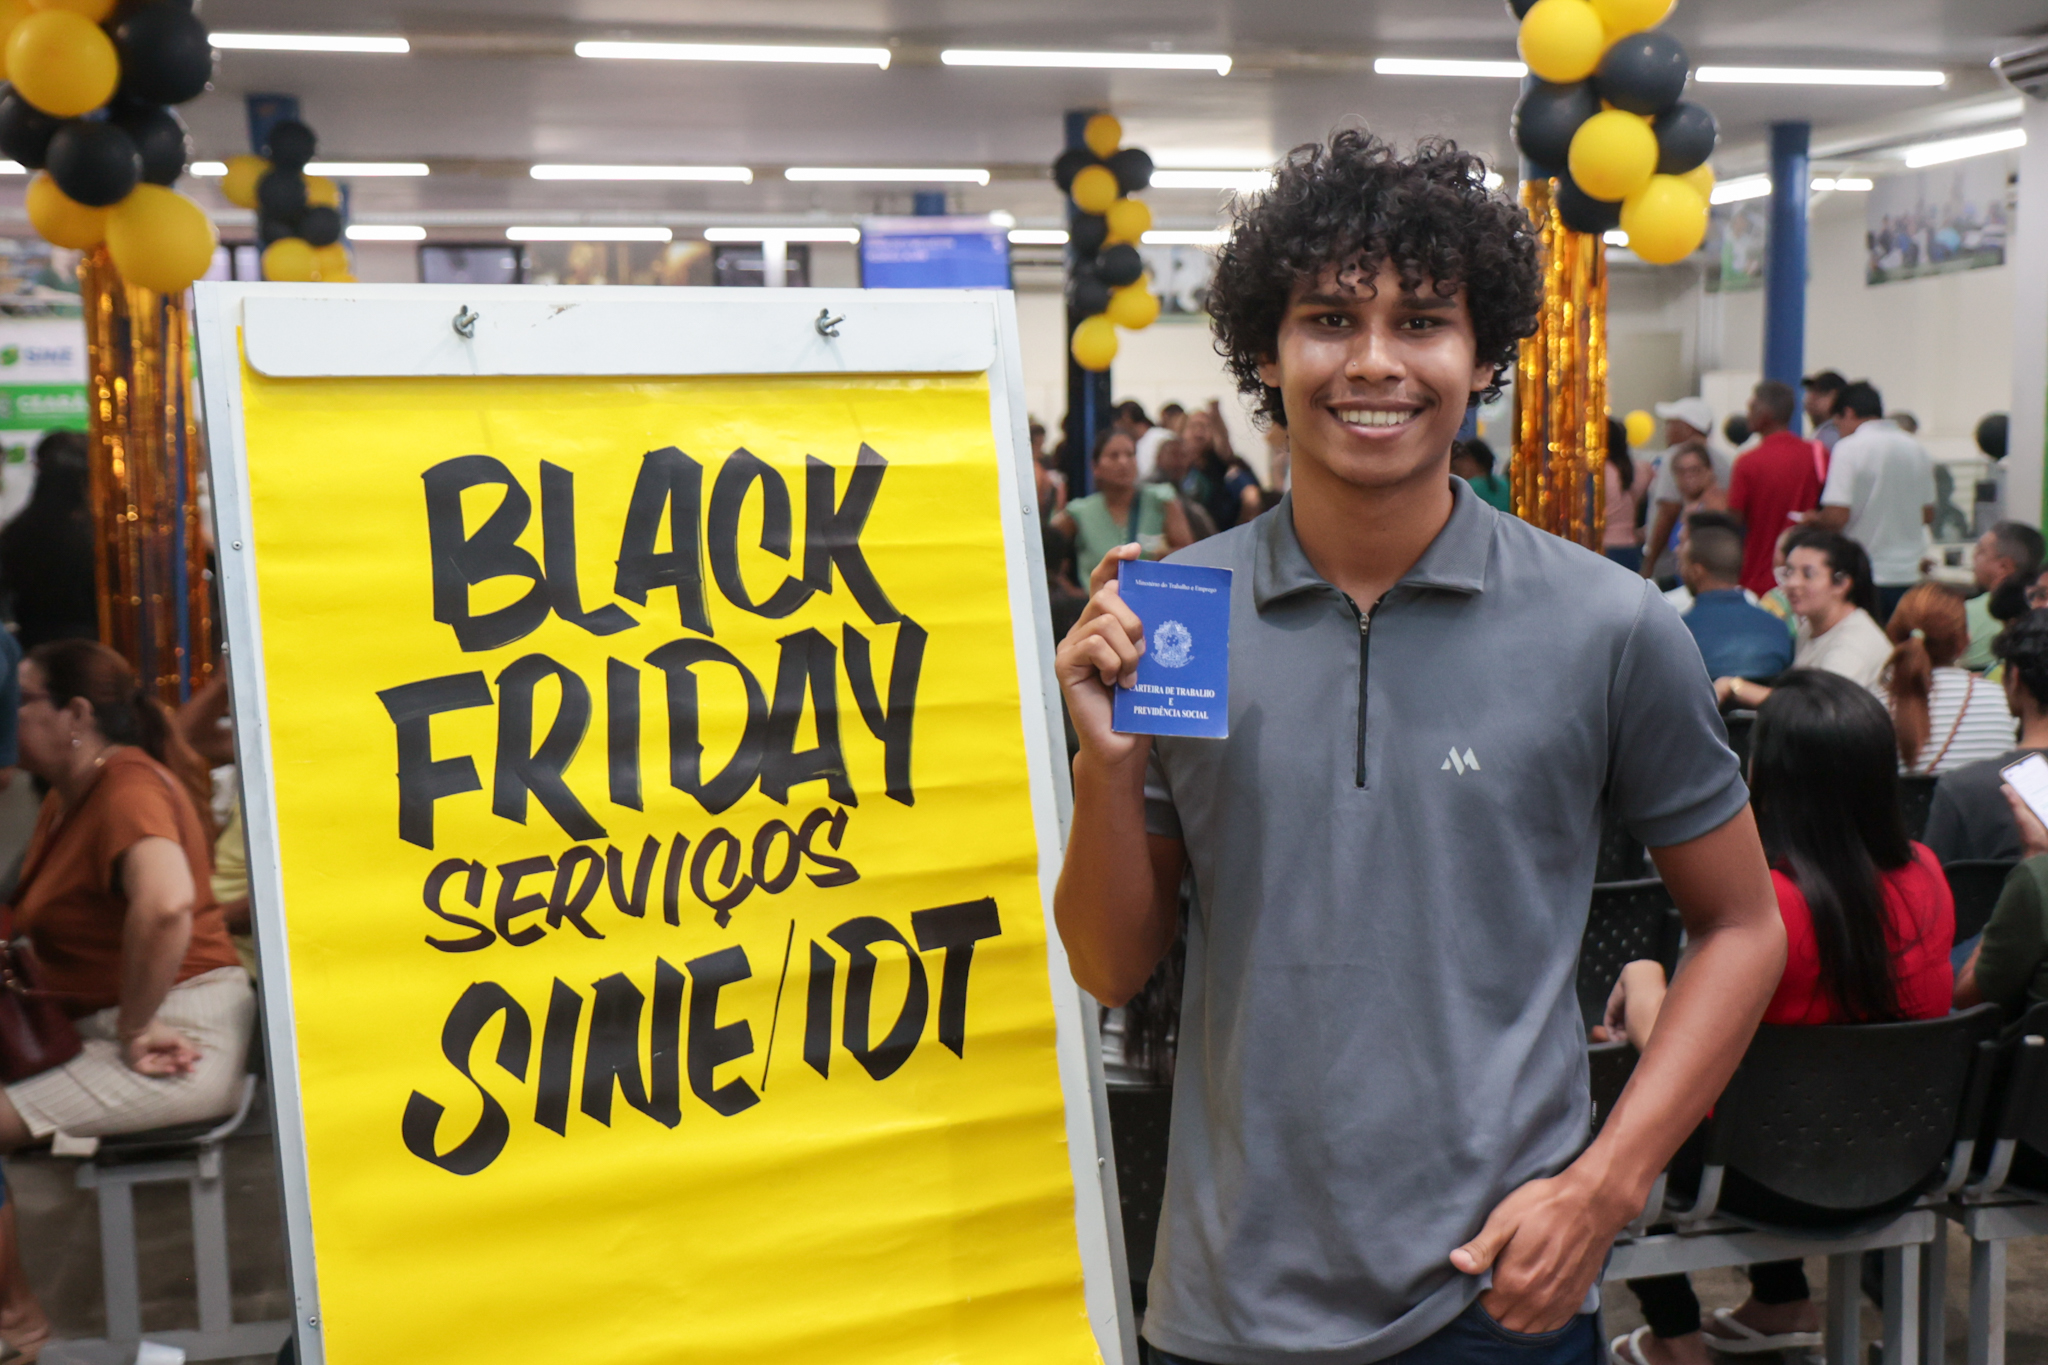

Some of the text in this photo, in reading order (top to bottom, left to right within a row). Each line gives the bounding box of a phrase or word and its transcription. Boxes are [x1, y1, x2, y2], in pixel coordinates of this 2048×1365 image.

[421, 441, 902, 653] BLACK
[1169, 582, 1190, 590] Trabalho
[1195, 585, 1217, 594] Emprego
[1133, 705, 1209, 719] PREVIDÊNCIA SOCIAL
[1165, 686, 1175, 695] DE
[1176, 687, 1216, 698] TRABALHO
[1168, 697, 1174, 706] E
[375, 614, 928, 851] FRIDAY
[422, 806, 861, 953] SERVIÇOS
[401, 896, 1002, 1176] SINE/IDT
